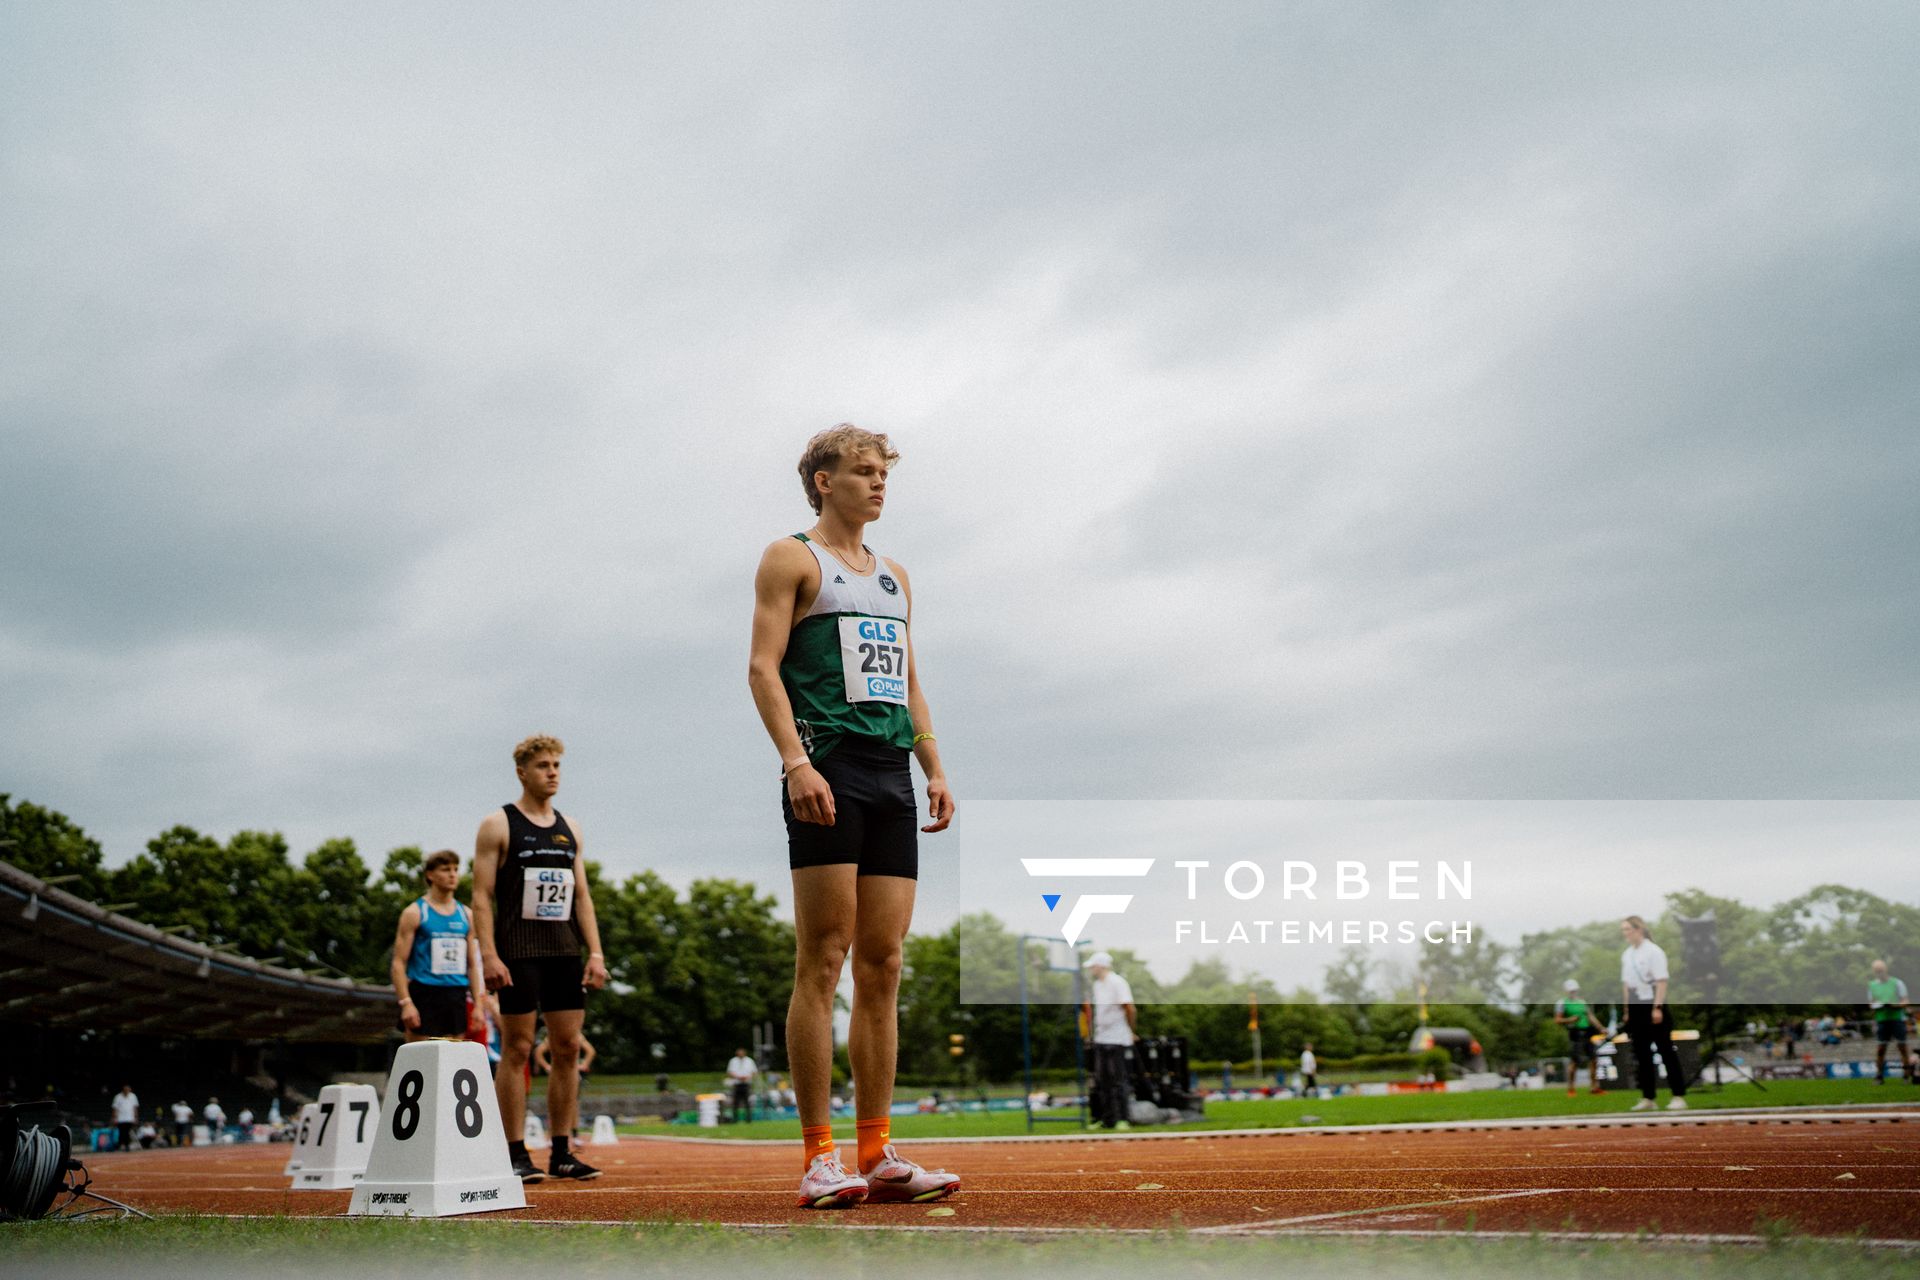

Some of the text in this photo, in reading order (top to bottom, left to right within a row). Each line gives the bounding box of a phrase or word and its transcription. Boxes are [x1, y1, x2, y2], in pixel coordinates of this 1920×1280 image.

[858, 621, 897, 642] GLS
[858, 643, 904, 676] 257
[539, 871, 564, 882] GLS
[536, 884, 567, 903] 124
[392, 1070, 424, 1141] 8
[453, 1068, 483, 1138] 8
[300, 1117, 311, 1145] 6
[316, 1103, 335, 1146] 7
[349, 1101, 369, 1143] 7
